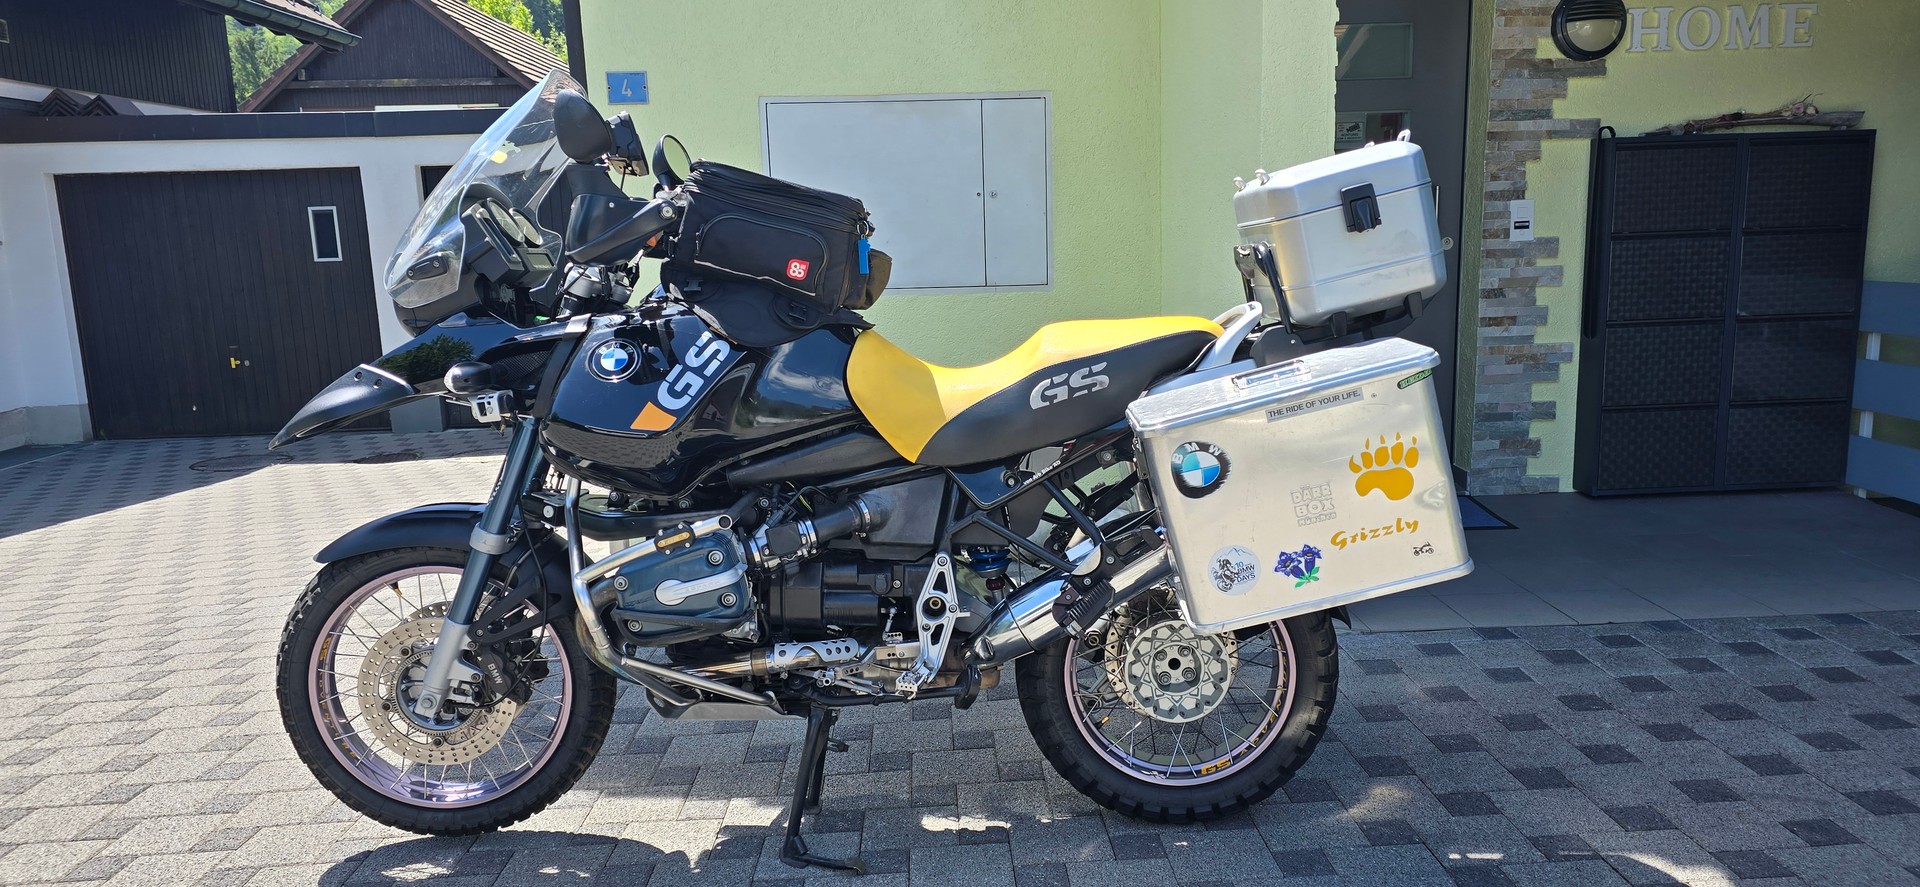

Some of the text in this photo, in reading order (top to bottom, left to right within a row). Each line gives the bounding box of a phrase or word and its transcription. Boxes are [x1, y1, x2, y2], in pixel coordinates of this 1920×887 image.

[1625, 3, 1818, 53] HOME
[621, 78, 633, 97] 4
[657, 330, 731, 410] GS
[1029, 361, 1110, 410] GS
[1267, 390, 1361, 418] THE RIDE OF YOUR LIFE.
[1171, 441, 1222, 465] BMW
[1294, 498, 1336, 518] BOX
[1330, 517, 1419, 551] Grizzly
[1235, 561, 1244, 569] 10
[1237, 564, 1255, 575] BMW
[1237, 572, 1256, 583] DAYS
[487, 663, 503, 684] BMW
[1200, 758, 1232, 776] GS
